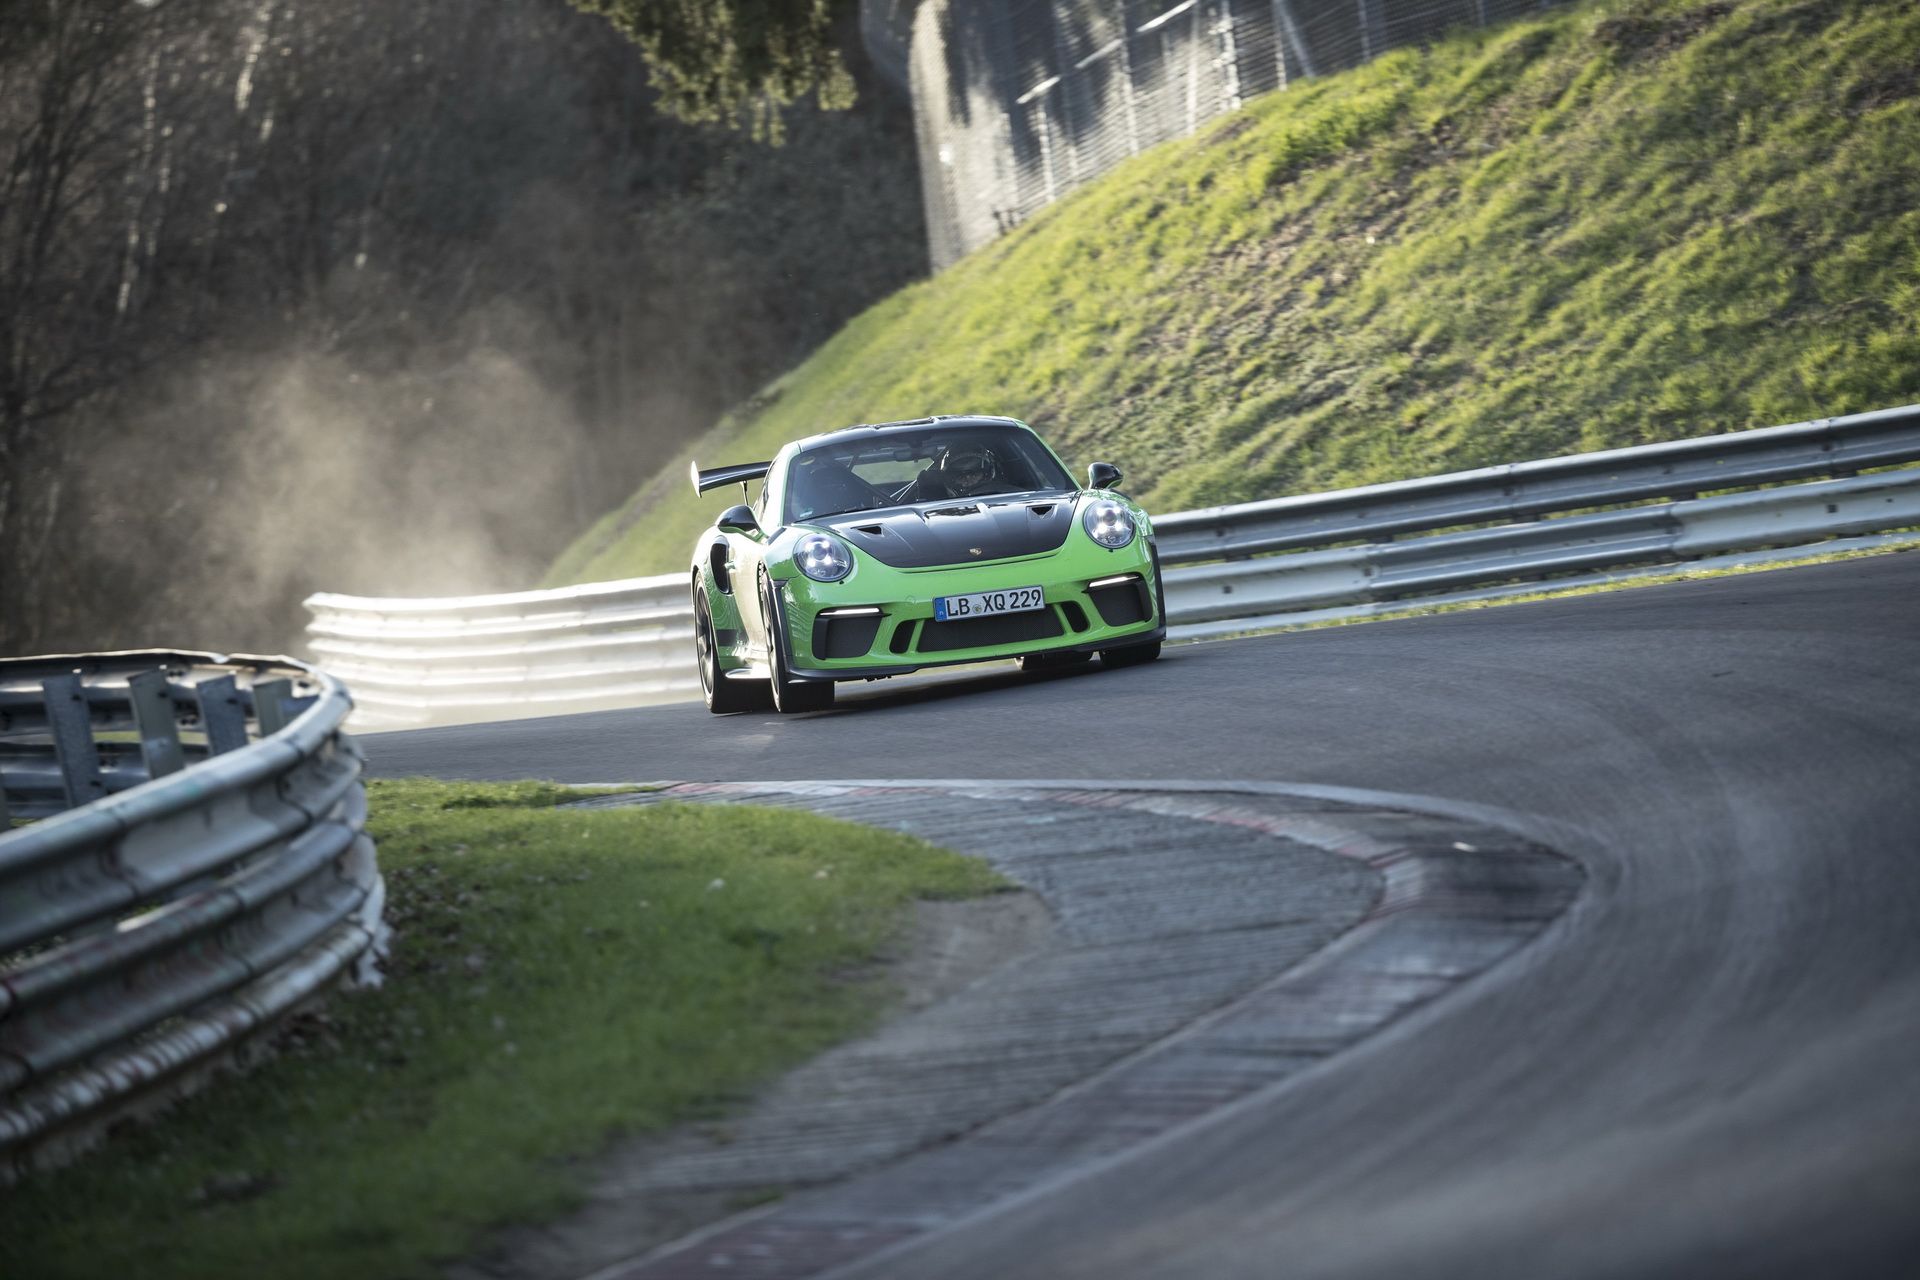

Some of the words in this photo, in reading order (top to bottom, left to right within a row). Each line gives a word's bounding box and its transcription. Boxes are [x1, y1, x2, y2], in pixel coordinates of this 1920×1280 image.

[946, 598, 970, 616] LB
[982, 593, 1006, 612] XQ
[1009, 589, 1041, 609] 229
